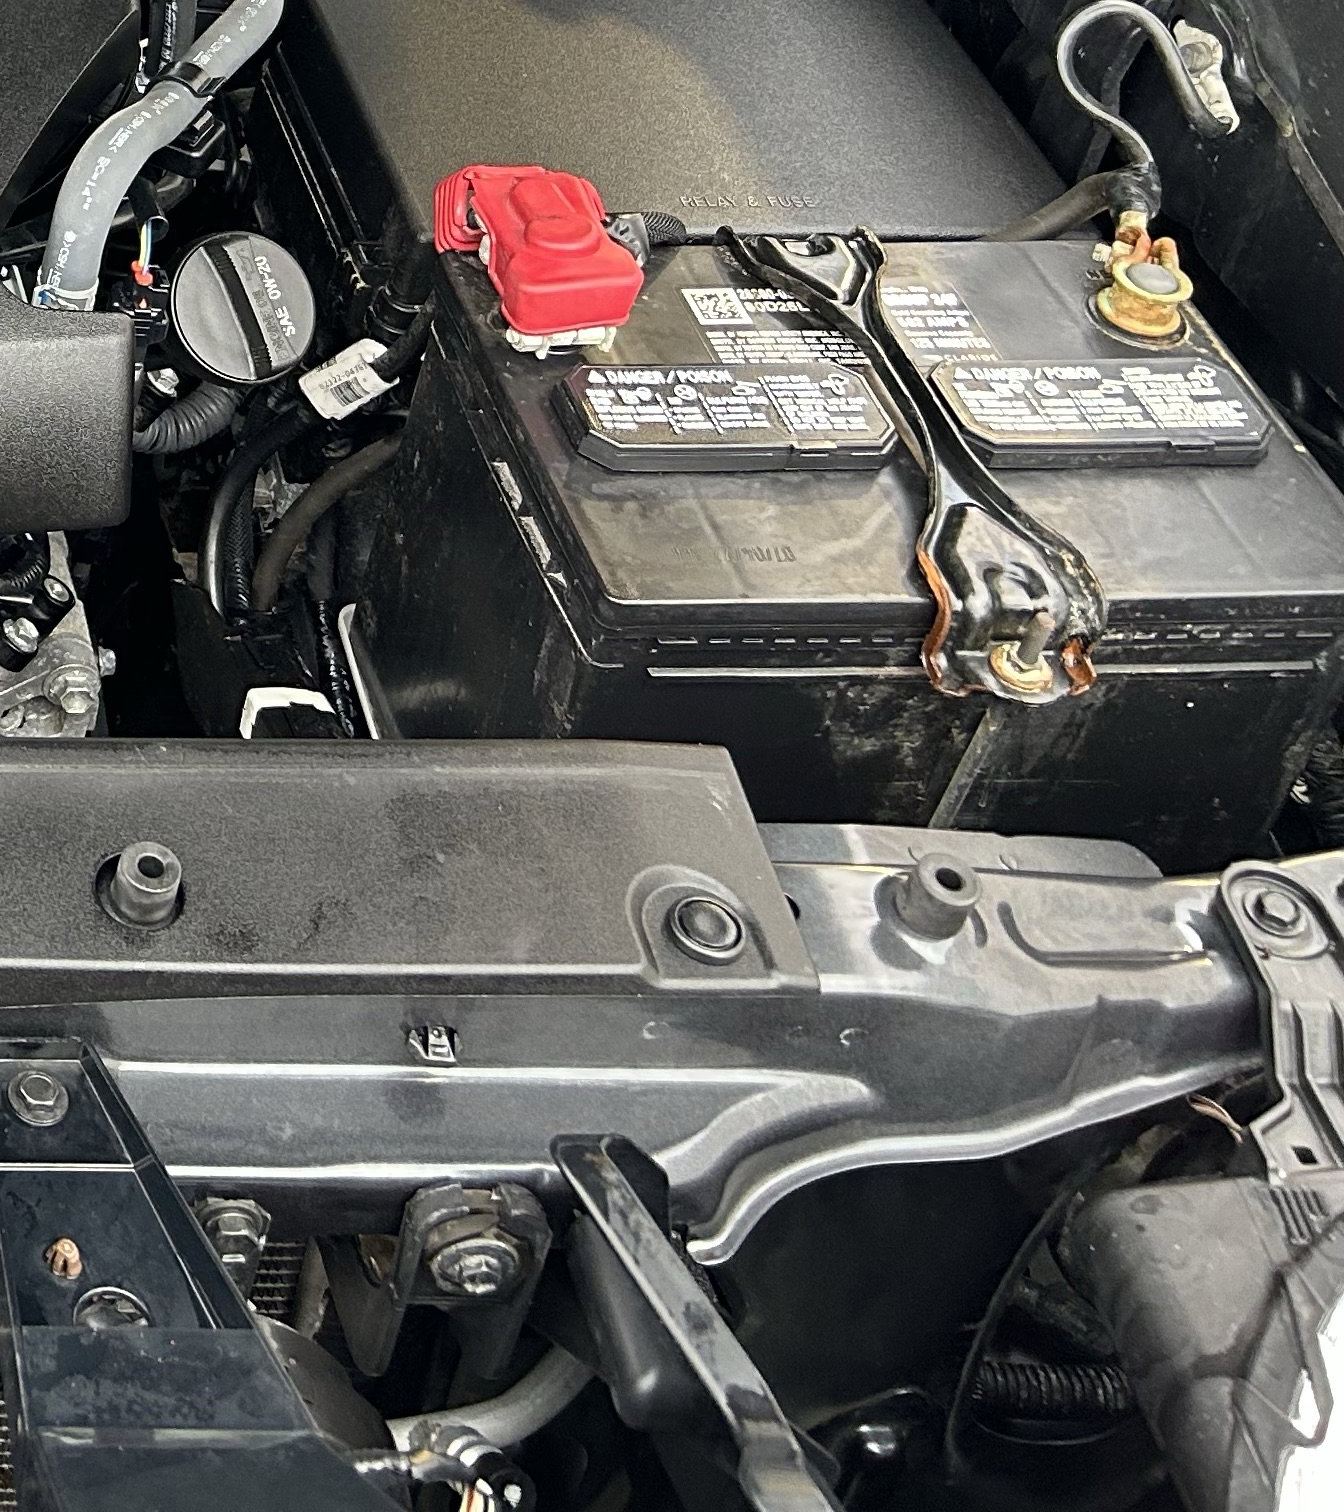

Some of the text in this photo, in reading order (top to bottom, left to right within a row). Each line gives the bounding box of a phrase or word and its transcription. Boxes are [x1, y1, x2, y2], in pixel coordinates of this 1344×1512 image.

[679, 195, 816, 208] RELAY & FUSE
[254, 255, 296, 337] SAE 0W-20
[605, 369, 666, 385] DANGER
[675, 369, 734, 384] POISON
[970, 367, 1033, 381] DANGER
[1042, 366, 1102, 380] POISON
